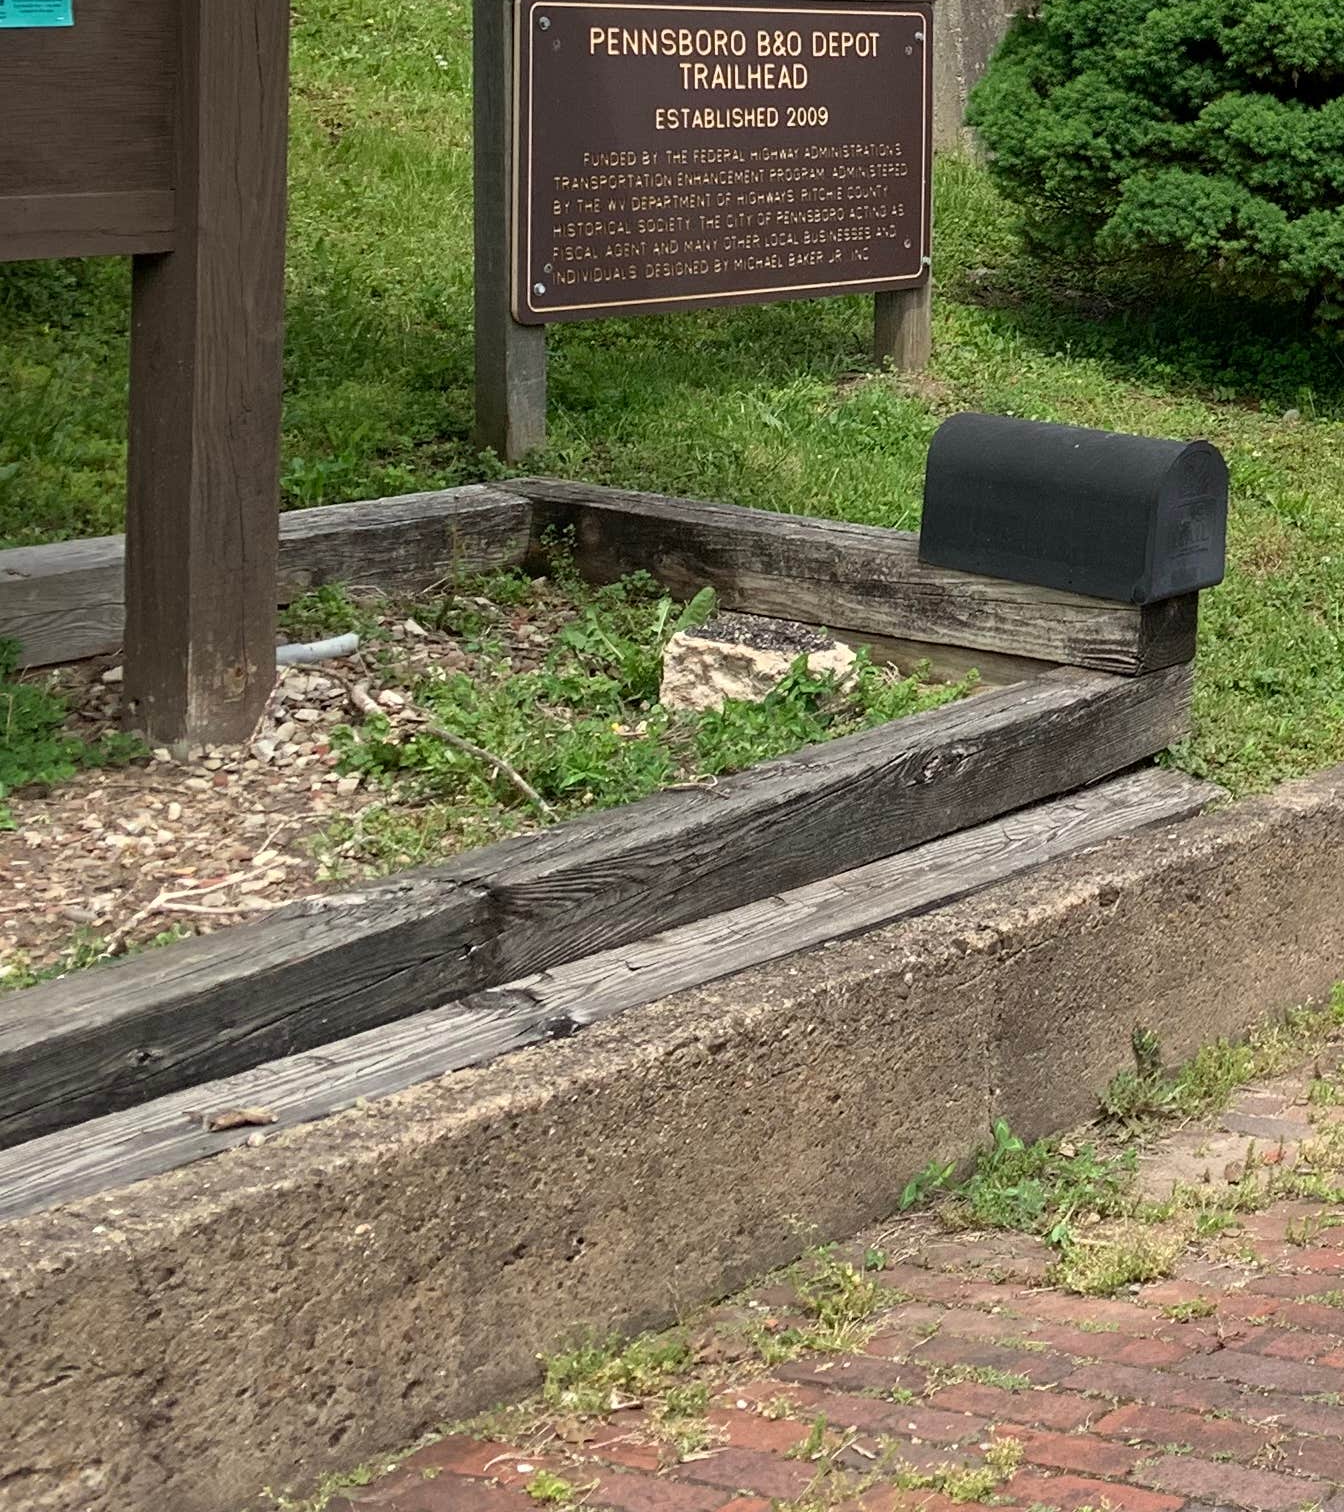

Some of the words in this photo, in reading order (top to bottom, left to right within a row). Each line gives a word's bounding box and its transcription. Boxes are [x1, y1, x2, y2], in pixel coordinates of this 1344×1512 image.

[589, 24, 746, 57] PENNSBORO
[757, 28, 802, 58] B&O
[812, 30, 880, 59] DEPOT
[679, 61, 808, 90] TRAILHEAD
[655, 106, 779, 130] ESTABLISHED
[786, 106, 828, 127] 2009
[583, 150, 636, 167] FUNDED
[641, 149, 657, 165] BY
[665, 149, 688, 165] THE
[692, 147, 745, 164] FEDERAL
[750, 145, 799, 162] HIGHWAY
[553, 171, 672, 193] TRANSPORTATION
[677, 167, 764, 187] ENHANCEMENT
[552, 199, 569, 216] BY
[576, 197, 600, 215] THE
[631, 192, 711, 211] DEPARTMENT
[716, 191, 731, 207] OF
[800, 185, 842, 202] RITCHIE
[847, 183, 888, 199] COUNTY
[553, 219, 631, 240] HISTORICAL
[698, 213, 720, 230] THE
[727, 212, 752, 228] CITY
[757, 210, 772, 226] OF
[776, 206, 845, 225] PENNSBORO
[849, 204, 886, 220] ACTING
[891, 203, 904, 218] AS
[552, 244, 598, 263] FISCAL
[605, 241, 646, 259] AGENT
[652, 238, 678, 256] AND
[683, 236, 718, 254] MANY
[724, 233, 760, 250] OTHER
[765, 230, 798, 247] LOCAL
[803, 225, 870, 244] BUSINESSES
[875, 223, 896, 239] AND
[644, 258, 708, 279] DESIGNED
[714, 257, 729, 273] BY
[733, 253, 783, 272] MICHAEL
[788, 249, 823, 267] BAKER
